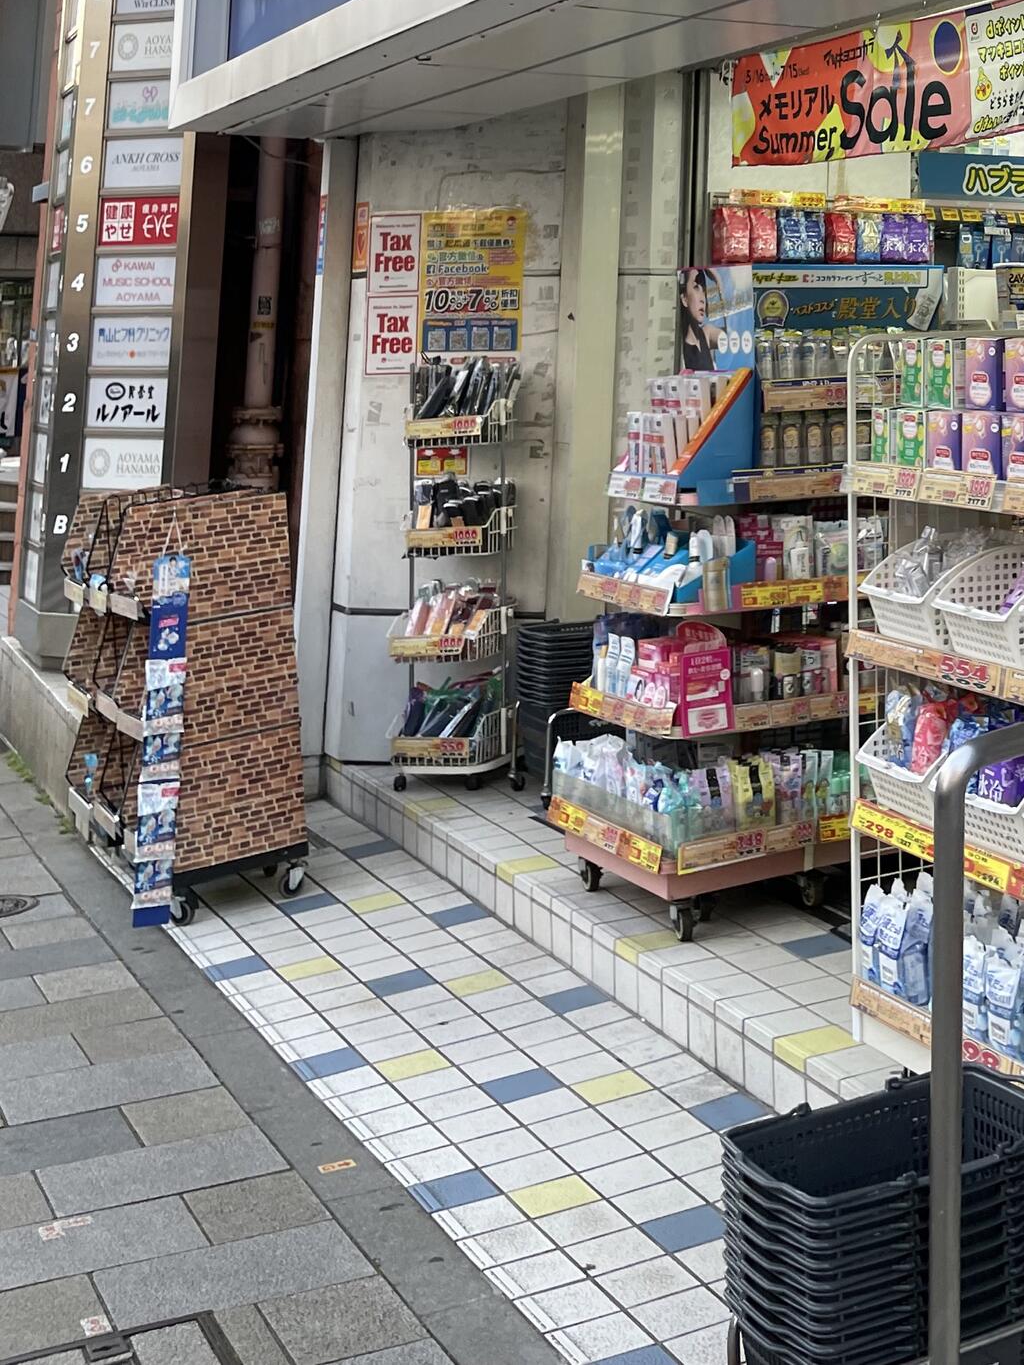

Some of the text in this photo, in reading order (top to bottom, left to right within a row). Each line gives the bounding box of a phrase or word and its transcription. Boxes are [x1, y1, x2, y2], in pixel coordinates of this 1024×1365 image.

[90, 41, 101, 59] 7
[84, 98, 96, 116] 7
[752, 125, 837, 155] Summer
[839, 55, 953, 150] Sale
[758, 83, 837, 122] メモリアル
[80, 156, 93, 175] 6
[112, 151, 181, 165] ANKH CROSS
[106, 204, 134, 220] 健康
[76, 214, 89, 232] 5
[105, 223, 133, 240] やせ
[143, 214, 174, 239] EVE
[380, 231, 413, 251] Tax
[123, 261, 156, 271] KAWAI
[374, 253, 415, 273] Free
[438, 263, 487, 274] Facebook
[71, 273, 85, 292] 4
[103, 277, 173, 287] MUSIC SCHOOL
[116, 292, 160, 303] AOYAMA
[838, 297, 917, 321] 殿堂入り
[376, 313, 409, 334] Tax
[66, 333, 79, 352] 3
[371, 334, 413, 355] Free
[62, 392, 76, 412] 2
[96, 404, 160, 423] ルノアール
[60, 453, 70, 473] 1
[117, 453, 160, 464] AOYAMA
[117, 464, 161, 475] HANAMO
[53, 515, 68, 534] B
[939, 654, 990, 683] 554
[866, 820, 895, 839] 298
